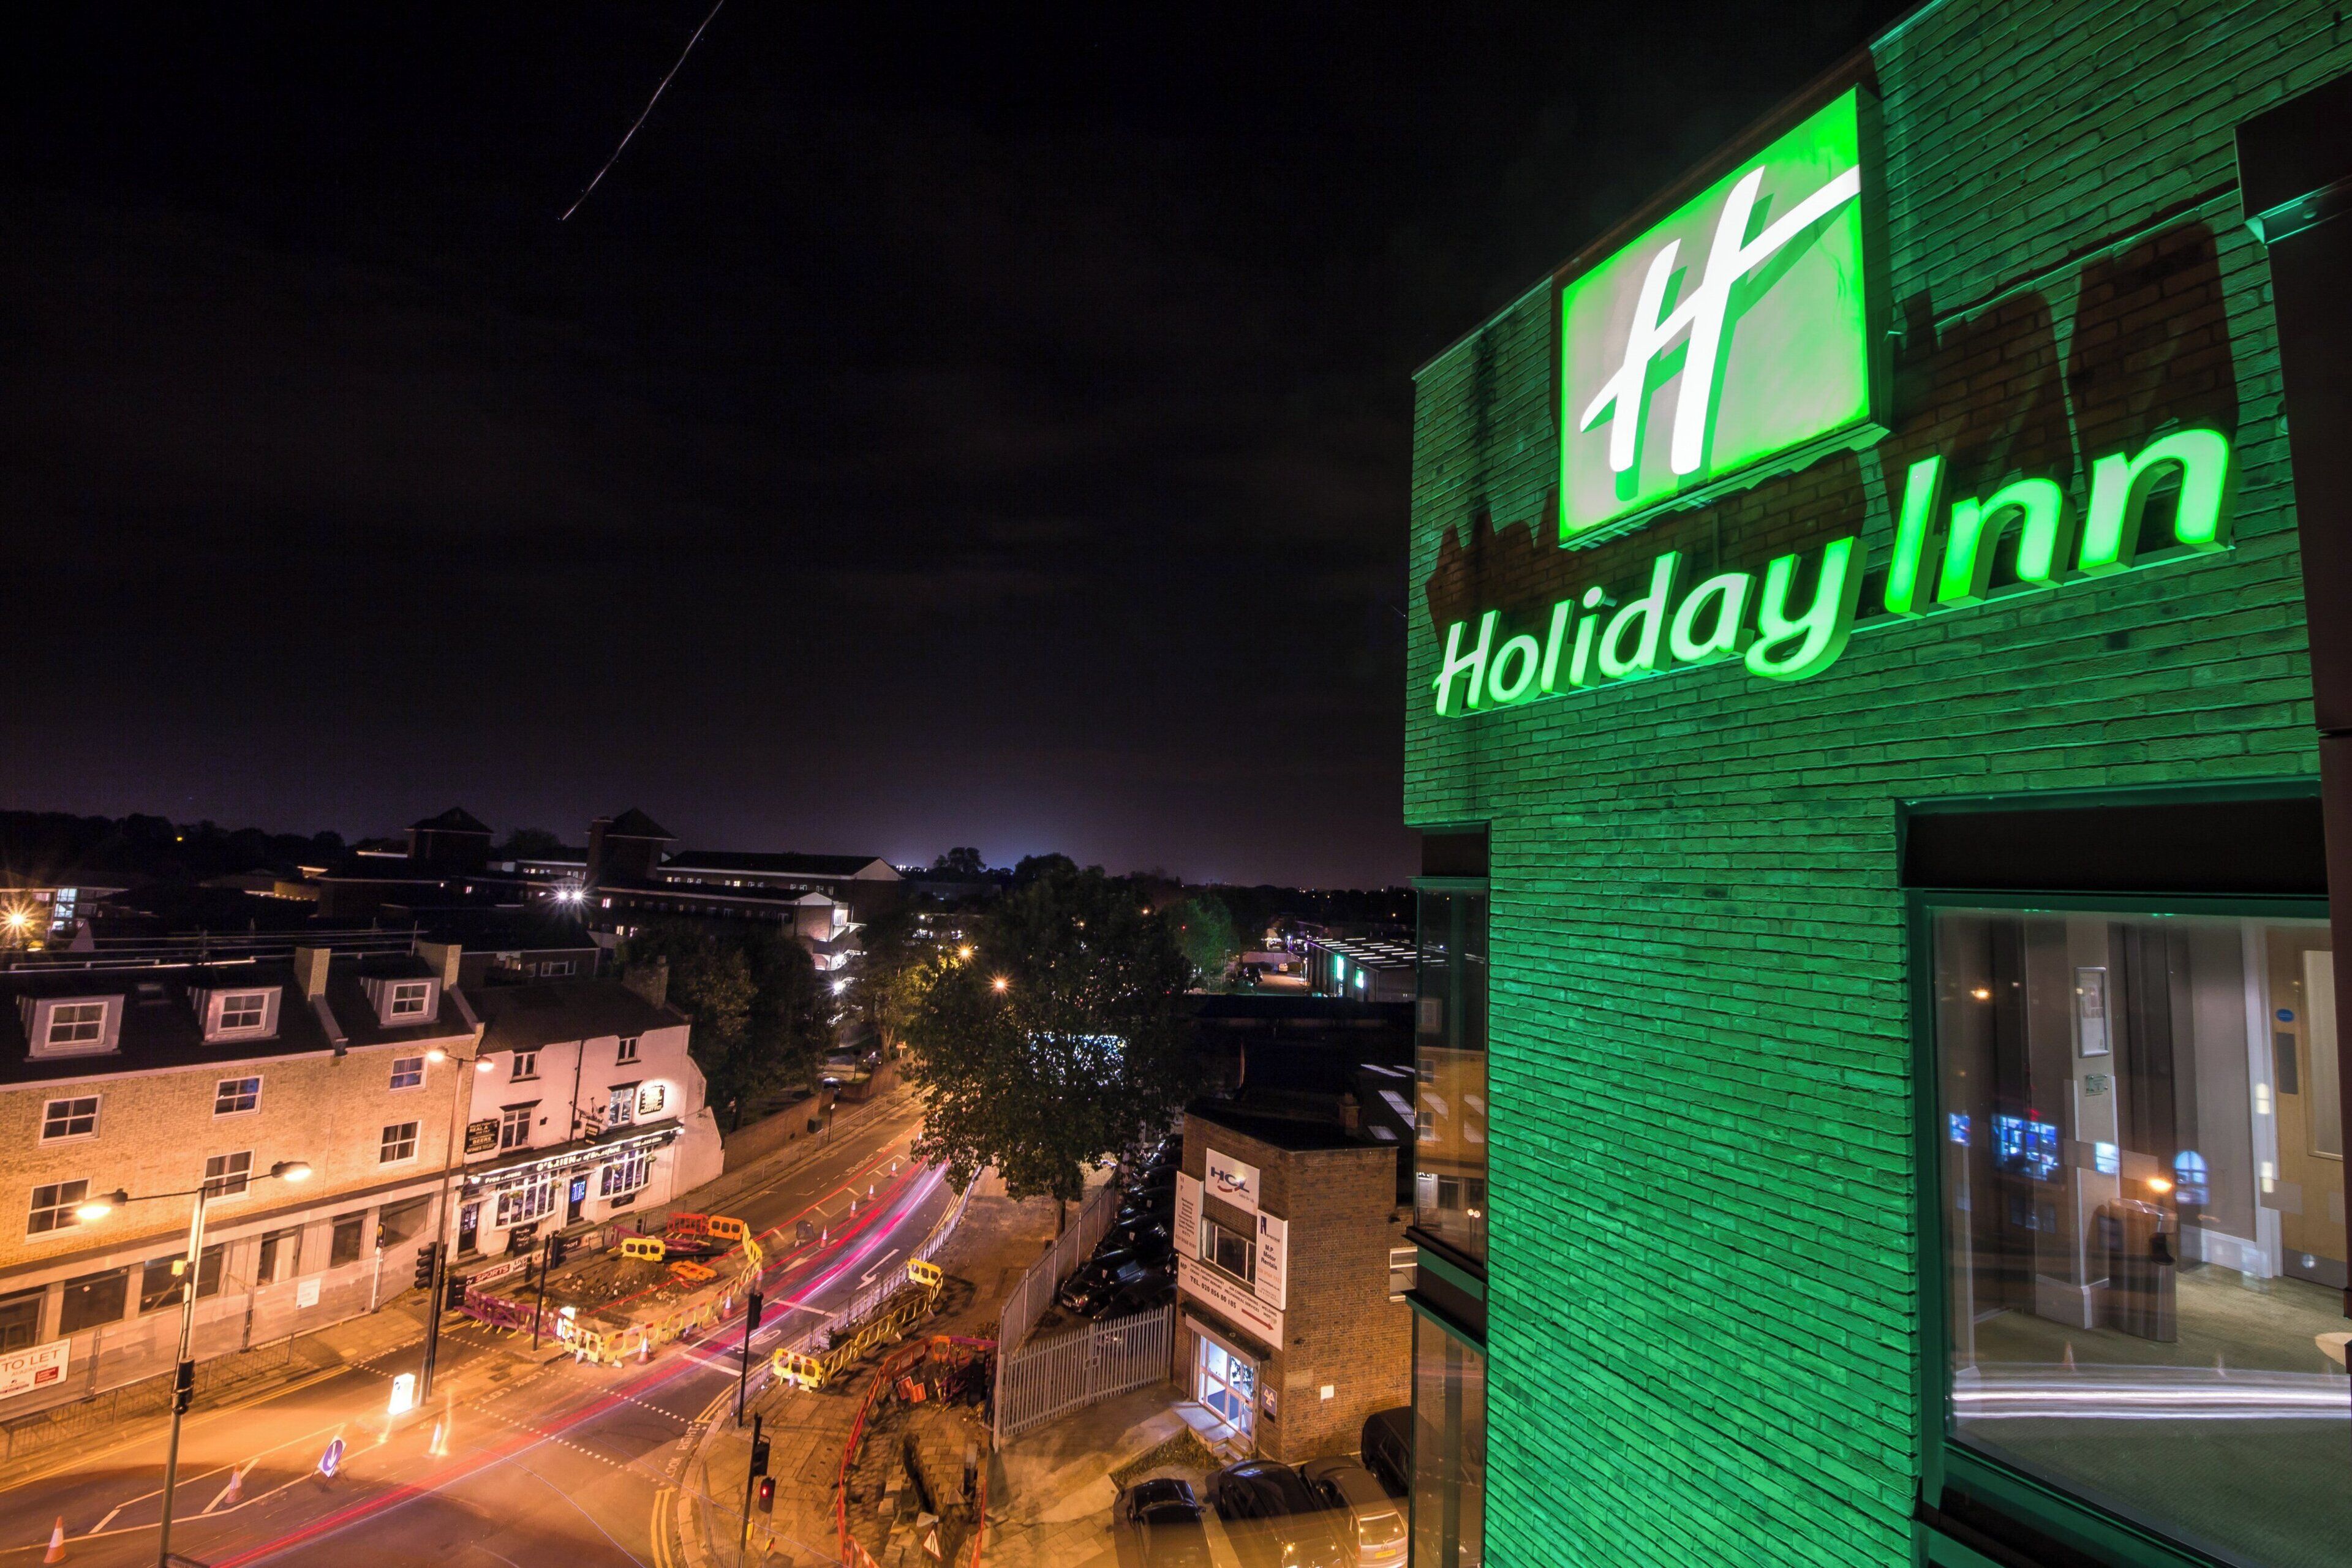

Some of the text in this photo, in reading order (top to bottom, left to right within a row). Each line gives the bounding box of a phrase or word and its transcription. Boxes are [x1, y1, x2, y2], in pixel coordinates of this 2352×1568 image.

[1433, 429, 2231, 717] Holiday Inn
[1263, 1251, 1276, 1262] Motor
[1265, 1244, 1274, 1254] M.P.
[1180, 1262, 1187, 1270] MP
[1261, 1257, 1278, 1270] Rentals
[476, 1265, 510, 1282] SPORTS
[1190, 1276, 1200, 1287] TEL.
[1201, 1283, 1210, 1292] 020
[1210, 1289, 1219, 1298] 856
[1221, 1294, 1227, 1303] 80
[1234, 1289, 1259, 1306] CONDITIONING
[1262, 1305, 1277, 1317] WELDING
[1245, 1301, 1259, 1313] SERVICES
[1, 1349, 61, 1372] TO LET
[676, 1426, 700, 1450] RIGHT
